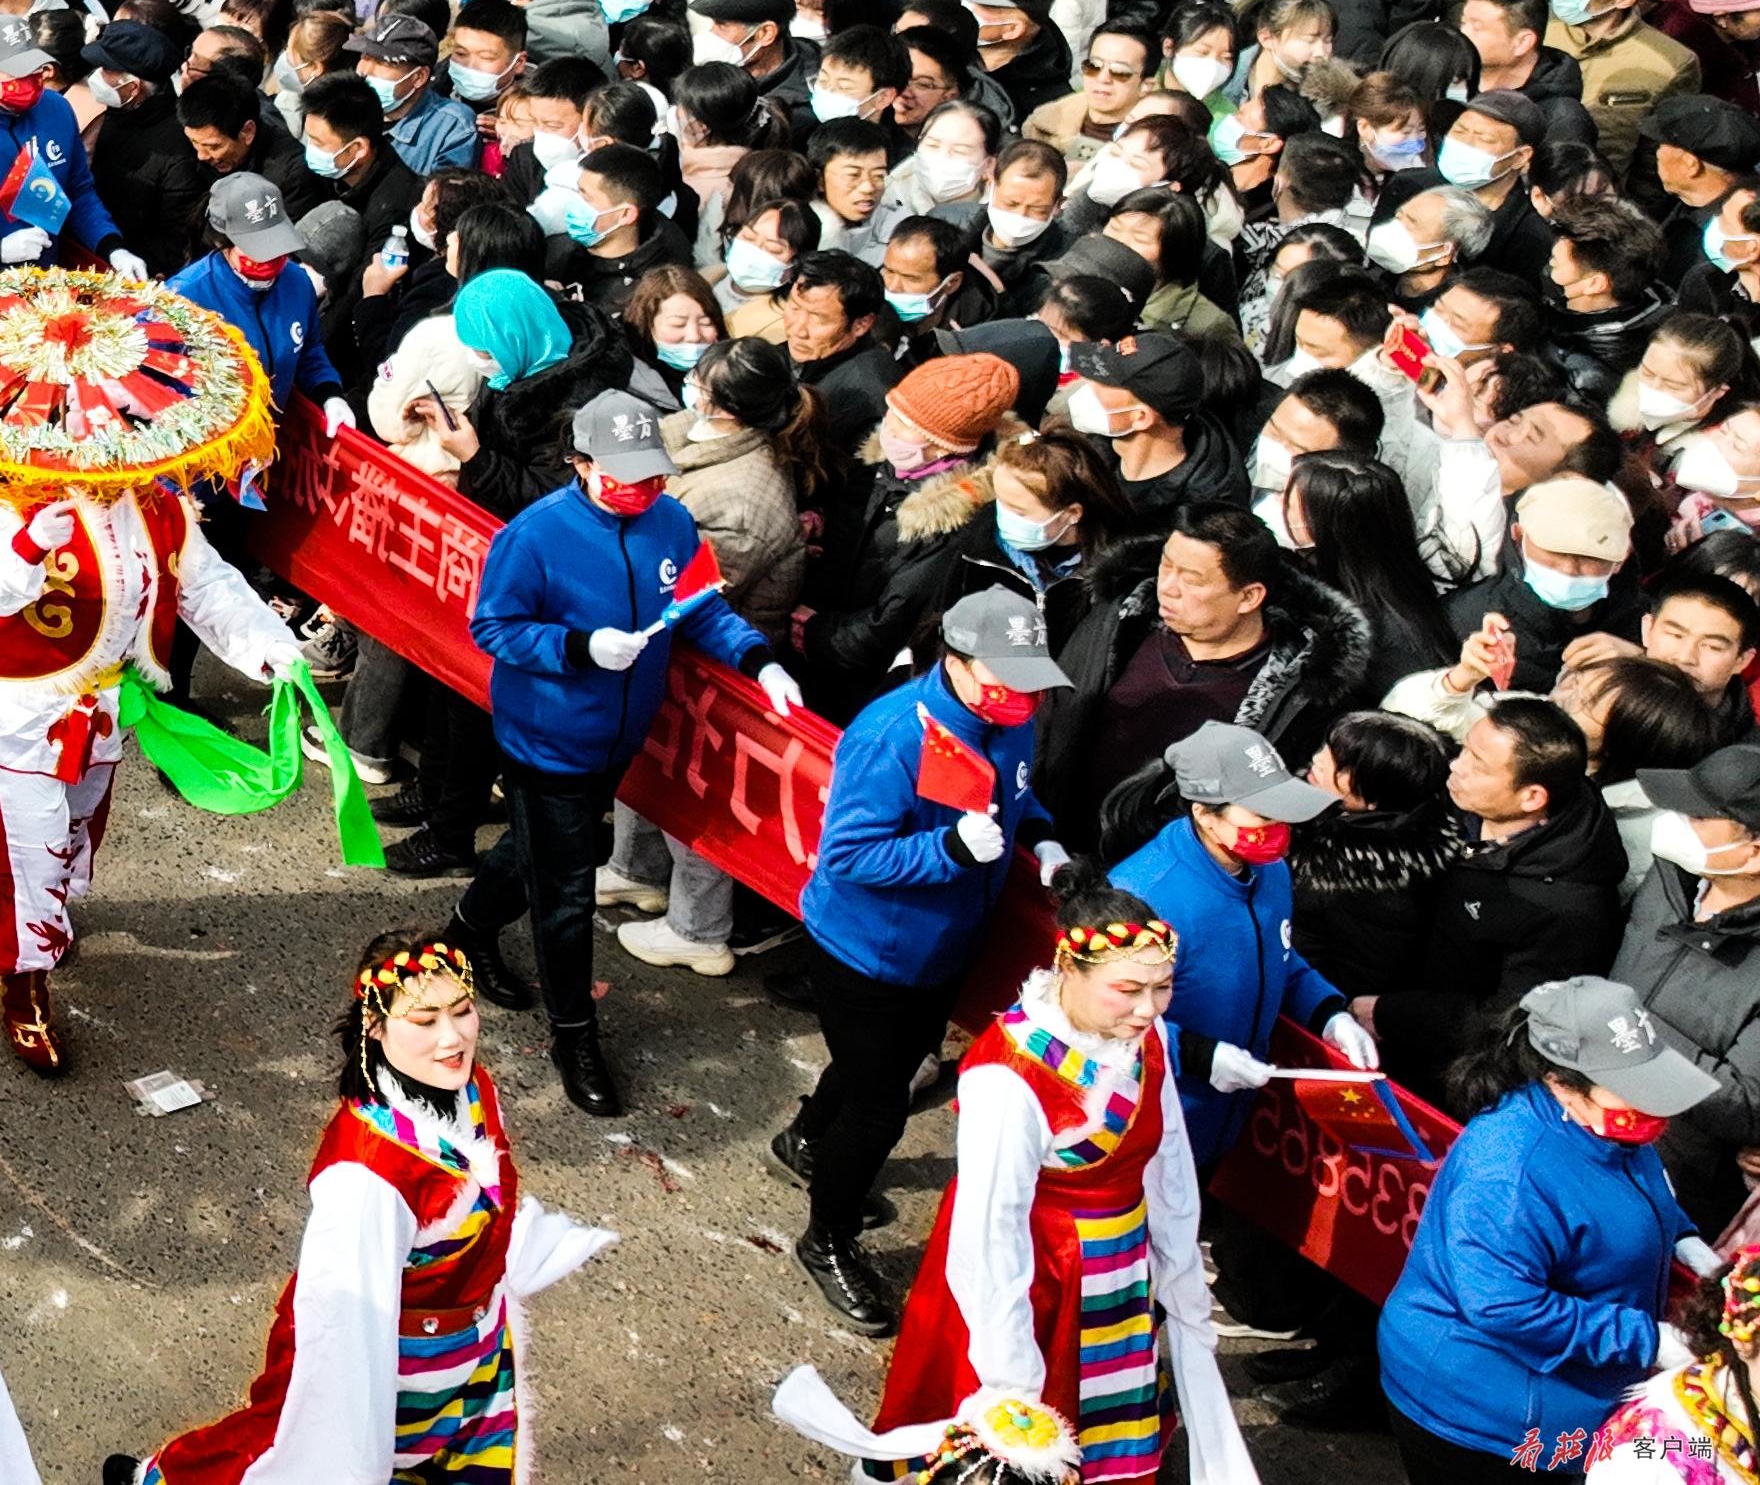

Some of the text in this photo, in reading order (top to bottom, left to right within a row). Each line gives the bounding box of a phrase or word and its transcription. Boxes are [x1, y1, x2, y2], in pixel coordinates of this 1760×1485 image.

[3, 22, 32, 47] 墨方
[245, 194, 279, 223] 墨方
[611, 413, 653, 442] 墨方
[1244, 742, 1286, 779] 墨
